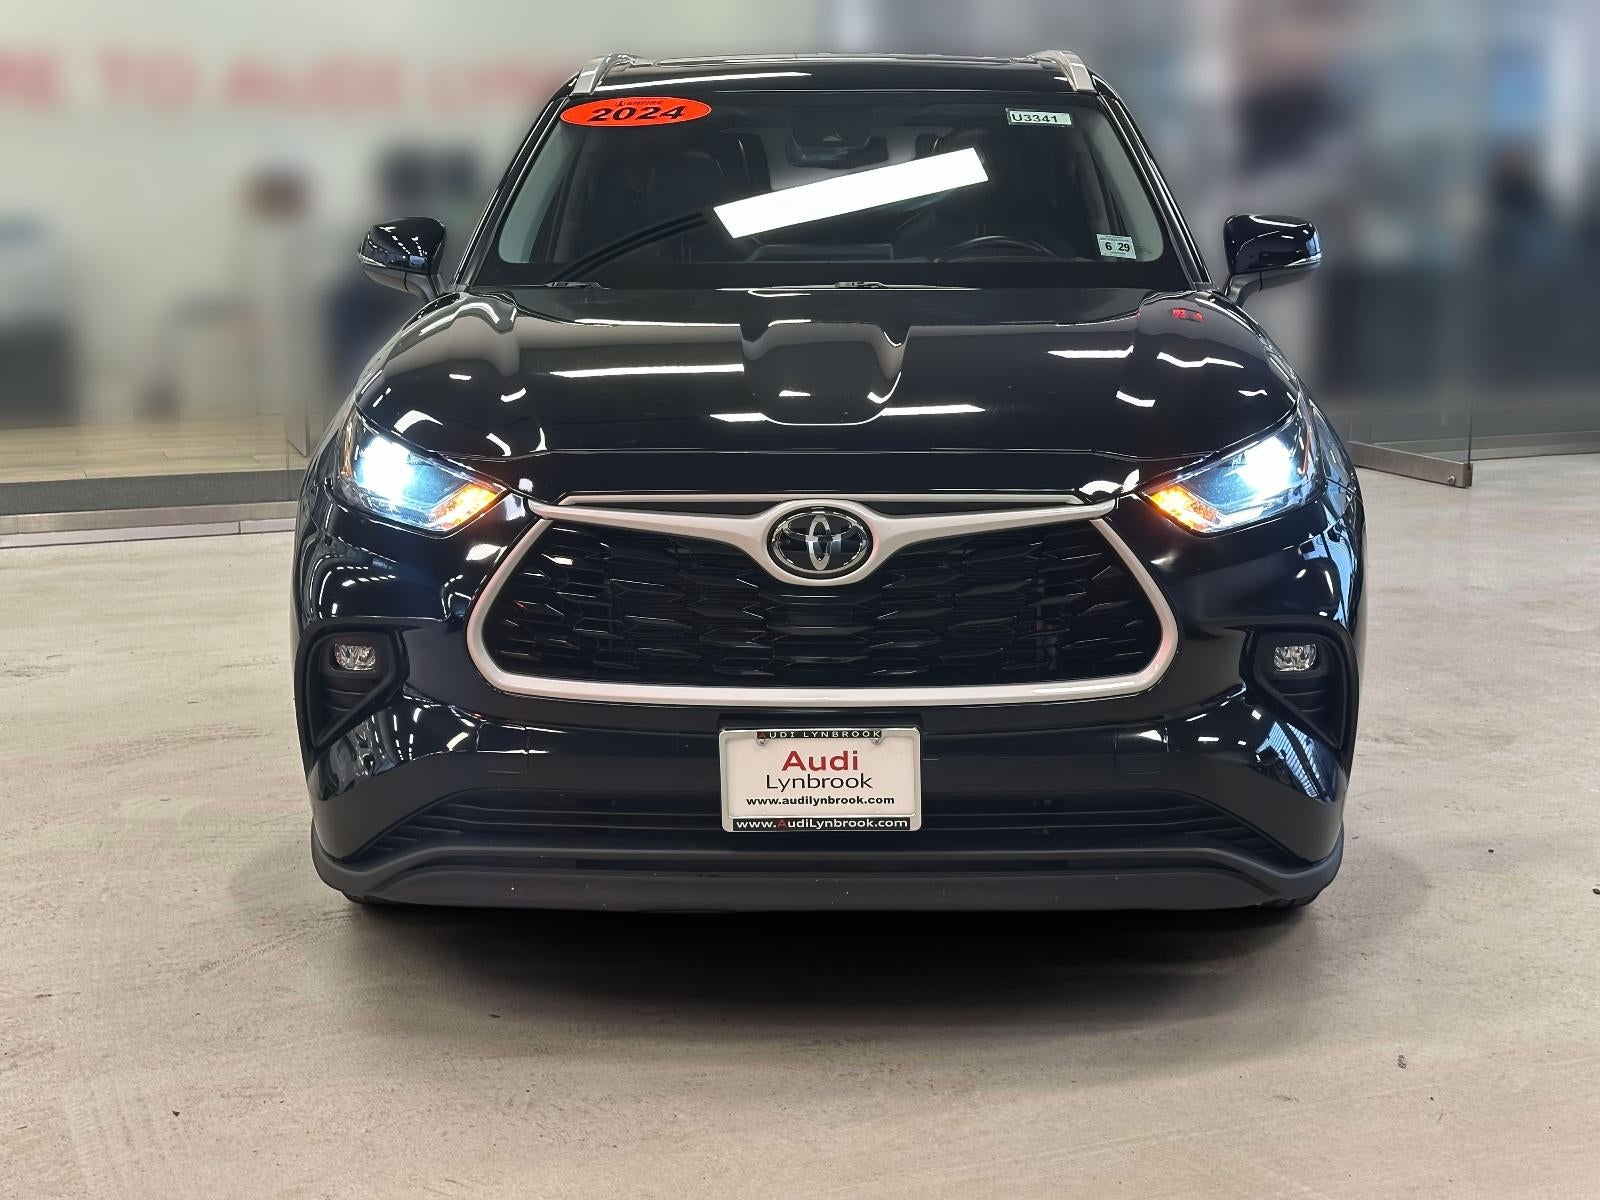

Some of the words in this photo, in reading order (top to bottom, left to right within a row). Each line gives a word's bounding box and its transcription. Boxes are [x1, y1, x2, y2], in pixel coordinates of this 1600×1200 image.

[587, 106, 687, 122] 2024
[1011, 113, 1058, 123] U3341
[1105, 242, 1112, 251] 6
[1118, 242, 1130, 252] 29
[758, 730, 795, 739] AUDI
[803, 730, 881, 738] LYNBROOK
[781, 750, 858, 771] Audi
[766, 773, 873, 792] Lynbrook
[746, 796, 895, 806] www.audilynbrook.com
[736, 818, 908, 829] www.AudiLynbrook.com
